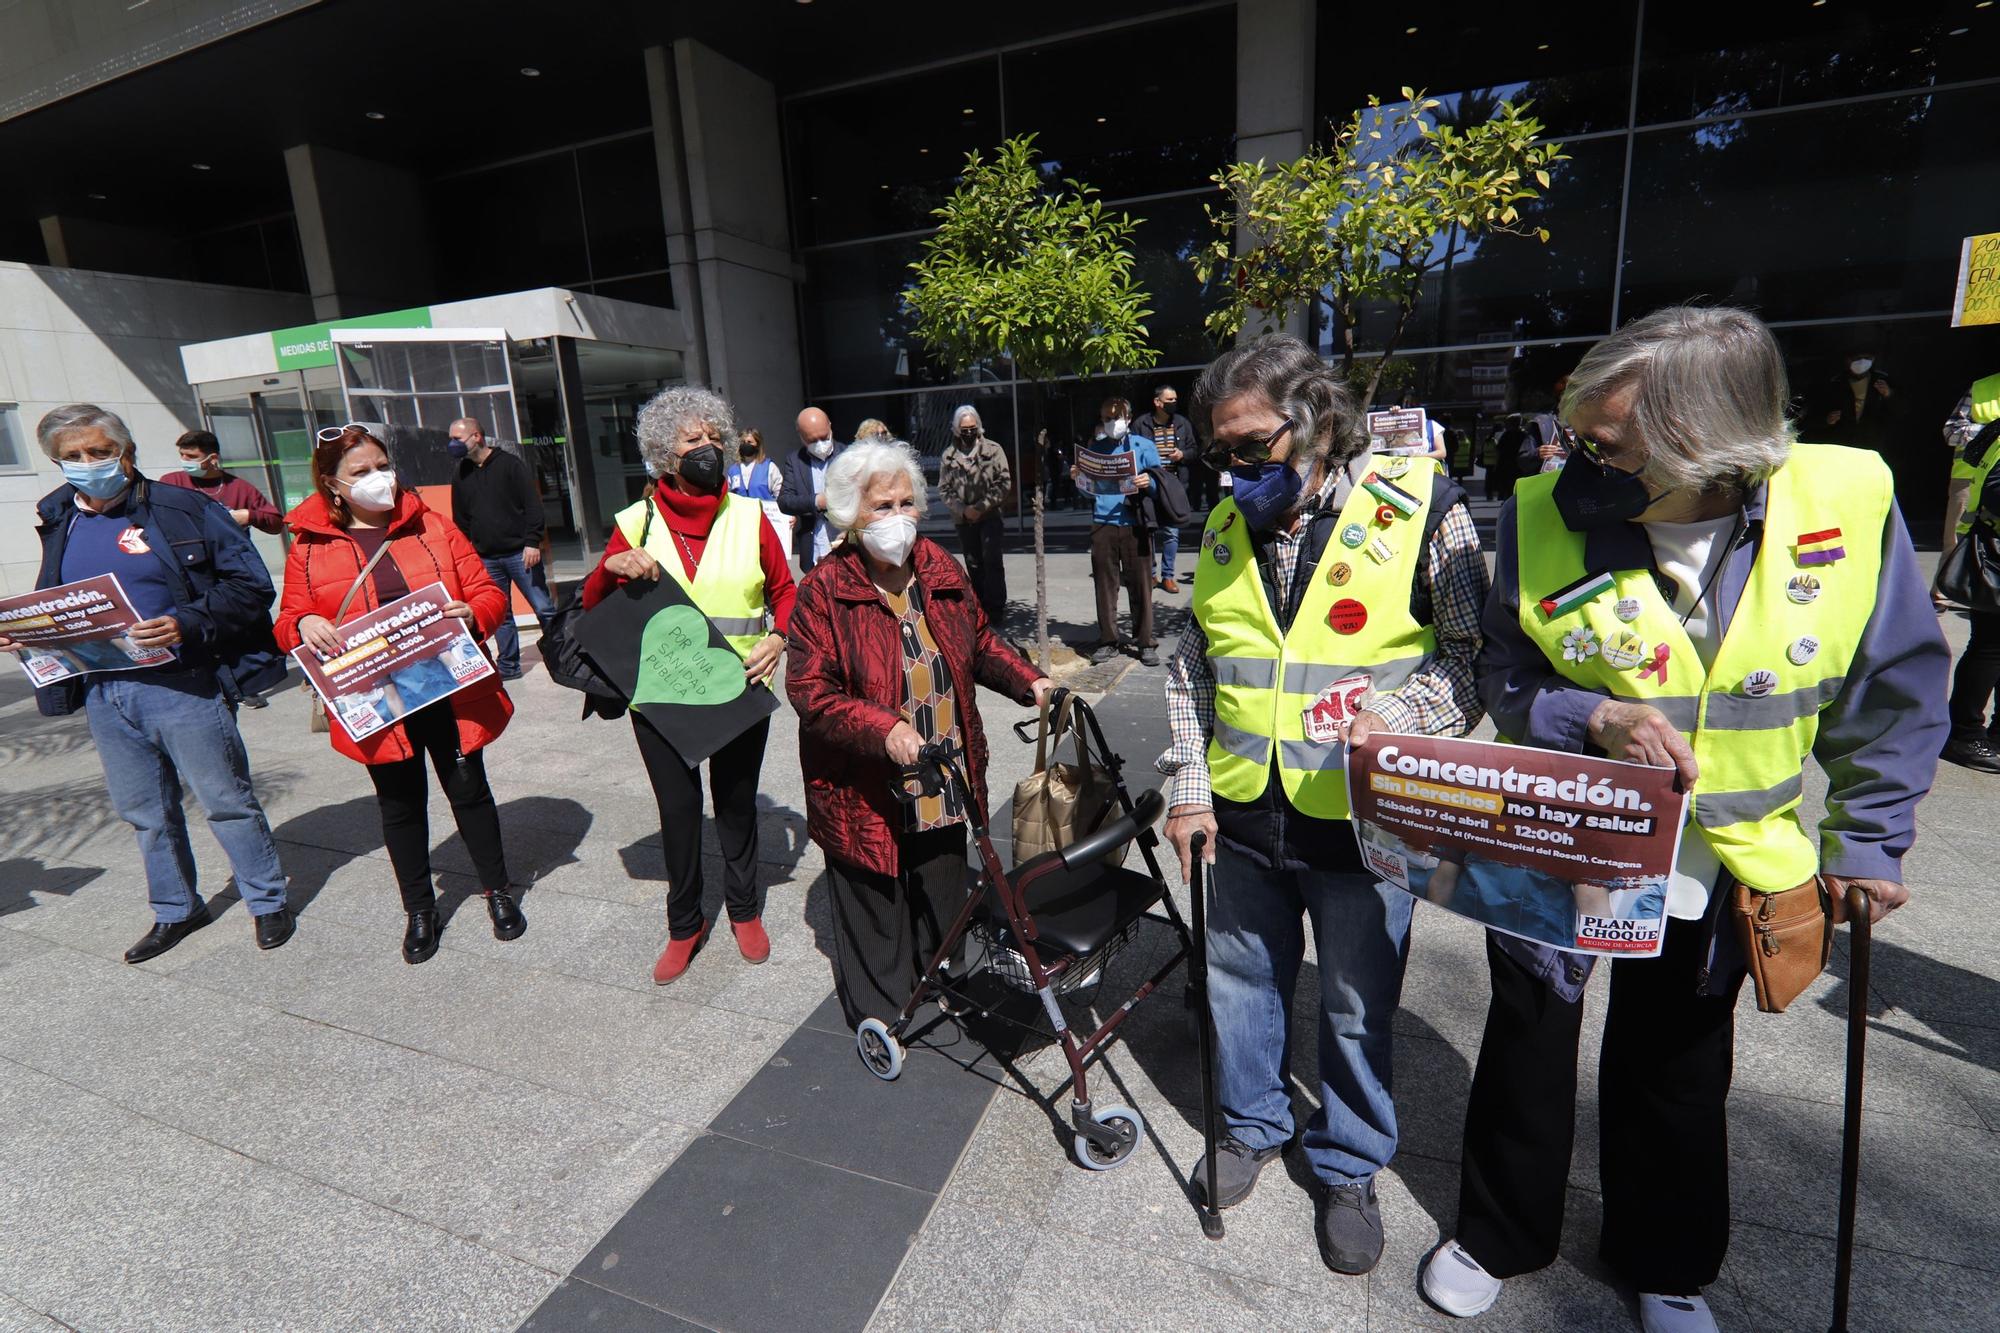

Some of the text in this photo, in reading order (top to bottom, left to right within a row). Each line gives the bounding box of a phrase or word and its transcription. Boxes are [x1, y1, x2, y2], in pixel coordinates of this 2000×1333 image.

[1969, 267, 2000, 284] CAL
[280, 340, 329, 357] MEDIDAS DE
[0, 589, 108, 621] oncentración.
[53, 601, 115, 622] no hay salud
[317, 601, 438, 662] centración.
[387, 632, 401, 643] no
[400, 623, 419, 636] hay
[397, 635, 425, 650] 12:00h
[668, 626, 714, 677] POR UNA
[1800, 643, 1815, 654] TTIP
[1801, 638, 1818, 648] STOP
[452, 660, 472, 673] PLAN
[455, 661, 486, 679] CHOQUE
[646, 654, 688, 698] PUBLICA
[658, 643, 706, 696] SANIDAD
[1314, 720, 1348, 734] PREC
[1377, 746, 1652, 811] Concentración.
[1373, 775, 1651, 833] Sin Derechos no hay salud
[1377, 798, 1574, 846] Sábado 17 de abril 12:00h
[1376, 812, 1642, 869] Paseo Alfonso XIII, 61 (frente hospital del Rosell), Cartagena
[1584, 916, 1635, 929] PLAN
[1582, 928, 1658, 941] CHOQUE
[1583, 939, 1611, 947] REGIÓN
